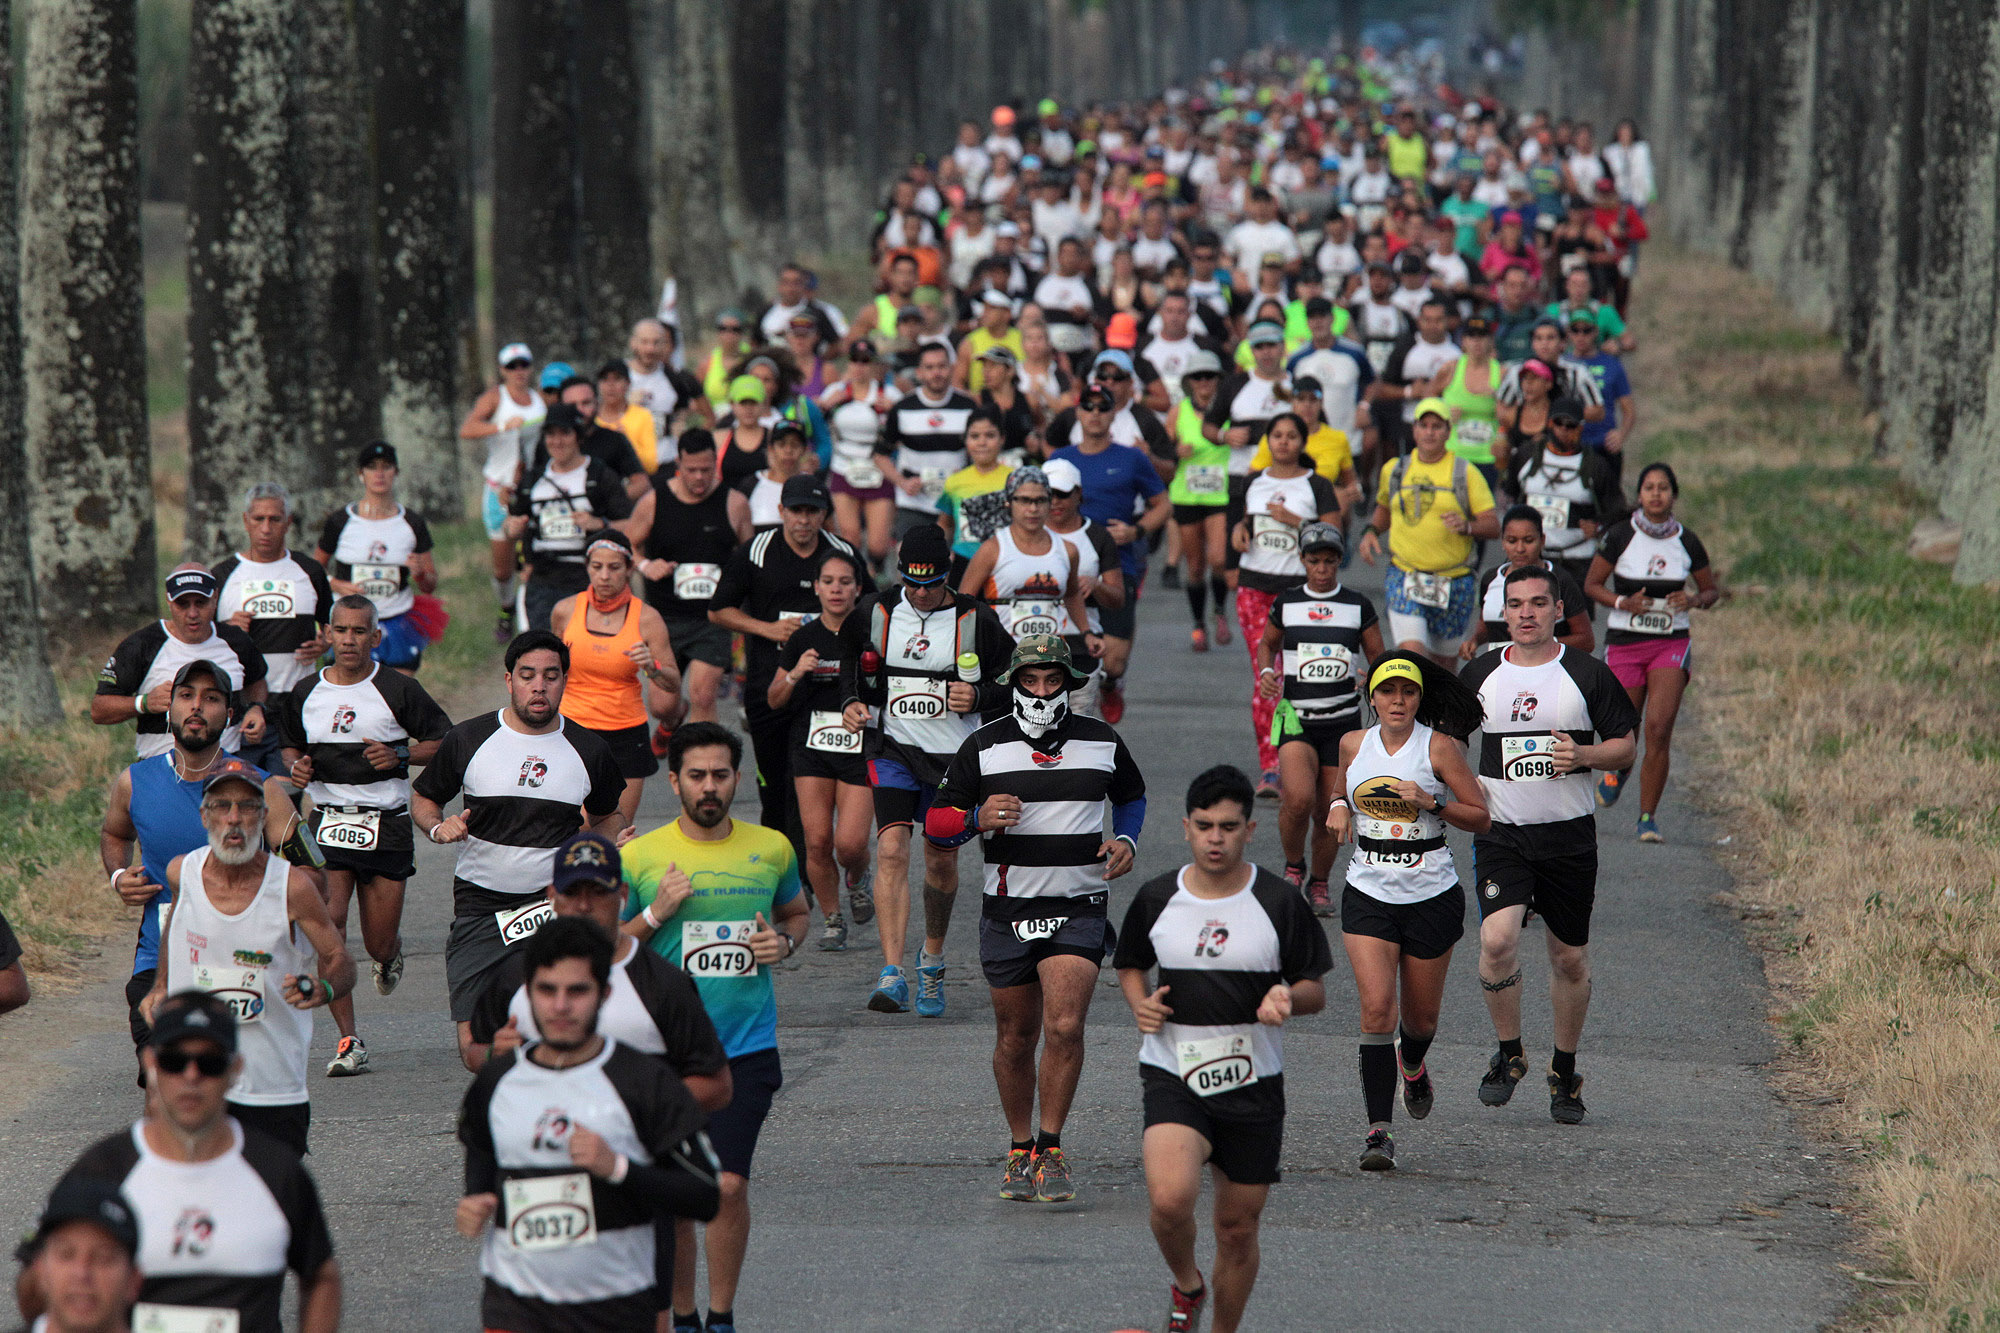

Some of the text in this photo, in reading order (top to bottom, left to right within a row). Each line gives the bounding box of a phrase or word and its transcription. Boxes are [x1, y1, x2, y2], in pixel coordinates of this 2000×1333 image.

[908, 563, 935, 575] KISS
[176, 575, 203, 586] QUAKER
[252, 600, 286, 613] 2850
[1022, 622, 1051, 634] 0695
[1308, 665, 1341, 678] 2927
[899, 701, 936, 714] 0400
[818, 731, 852, 747] 2899
[1515, 761, 1555, 777] 0698
[1363, 800, 1408, 808] ULTRAIL
[1365, 806, 1412, 815] RUNNERS
[328, 828, 366, 845] 4085
[513, 909, 553, 935] 3002
[1027, 918, 1066, 935] 093
[699, 952, 745, 971] 0479
[1198, 1064, 1242, 1089] 0541
[523, 1215, 574, 1240] 3037
